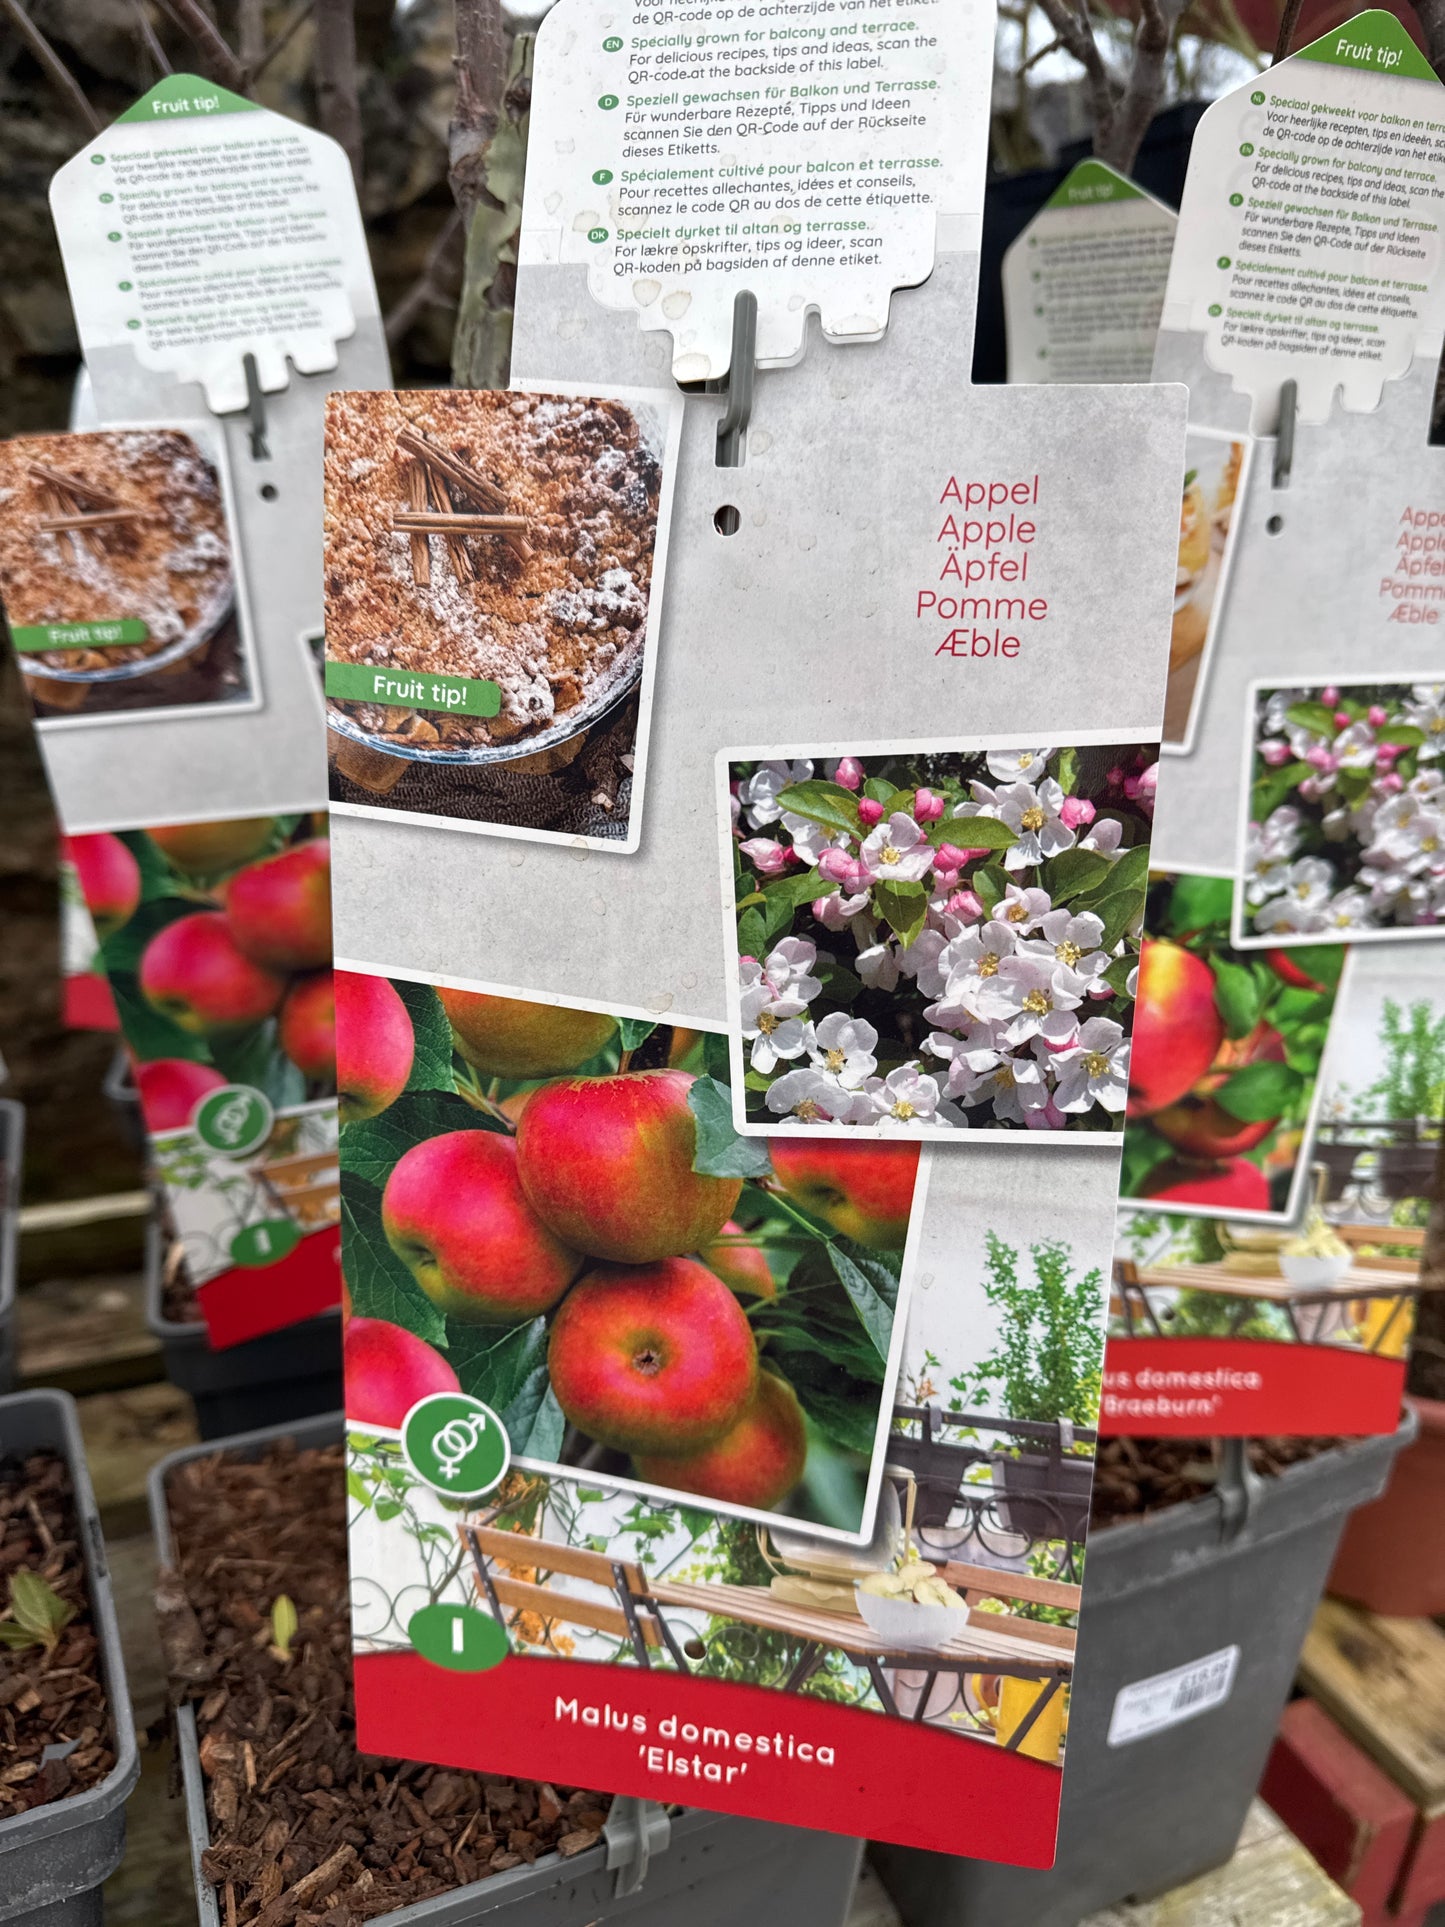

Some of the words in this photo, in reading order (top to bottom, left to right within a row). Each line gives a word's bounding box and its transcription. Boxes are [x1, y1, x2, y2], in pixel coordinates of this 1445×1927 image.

[633, 13, 649, 24] de
[653, 9, 712, 25] QR-code
[716, 10, 733, 21] op
[738, 6, 754, 17] de
[759, 2, 835, 16] achterzijde
[840, 0, 864, 10] van
[606, 40, 619, 48] EN
[696, 34, 739, 47] grown
[744, 30, 765, 41] for
[770, 28, 825, 39] balcony
[830, 23, 857, 35] and
[862, 22, 918, 33] terrace.
[630, 54, 651, 66] For
[655, 51, 712, 64] delicious
[717, 48, 768, 61] recipes,
[773, 45, 797, 59] tips
[801, 42, 828, 55] and
[832, 41, 872, 52] ideas,
[877, 40, 909, 50] scan
[915, 36, 936, 47] the
[1336, 39, 1373, 63] Fruit
[1377, 47, 1403, 69] tip!
[690, 70, 705, 79] at
[709, 66, 730, 77] the
[735, 62, 795, 76] backside
[799, 60, 814, 72] of
[818, 60, 842, 71] this
[847, 56, 883, 69] label.
[152, 98, 190, 114] Fruit
[193, 94, 220, 112] tip!
[605, 98, 612, 106] D
[627, 93, 678, 108] Speziell
[683, 90, 759, 106] gewachsen
[765, 87, 785, 98] für
[790, 85, 838, 97] Balkon
[844, 82, 870, 94] und
[875, 80, 940, 92] Terrasse.
[625, 112, 646, 123] Für
[651, 108, 731, 121] wunderbare
[800, 103, 836, 116] Tipps
[841, 99, 867, 111] und
[872, 98, 910, 109] Ideen
[1270, 96, 1309, 110] Speciaal
[1311, 104, 1355, 118] gekweekt
[1358, 112, 1378, 121] voor
[1381, 114, 1410, 126] balkon
[624, 129, 678, 140] scannen
[683, 126, 702, 137] Sie
[707, 125, 731, 136] den
[803, 119, 826, 131] auf
[831, 118, 854, 129] der
[859, 116, 926, 129] Rückseite
[1268, 111, 1288, 122] Voor
[1290, 114, 1327, 129] heerlijke
[1329, 123, 1369, 137] recepten,
[1373, 129, 1387, 139] tips
[1403, 133, 1432, 147] ideeën,
[622, 146, 663, 157] dieses
[668, 143, 719, 155] Etiketts.
[1263, 126, 1274, 136] de
[1277, 128, 1315, 143] QR-code
[1318, 137, 1329, 146] op
[1332, 137, 1343, 147] de
[1345, 140, 1392, 155] achterzijde
[1395, 149, 1410, 157] van
[1412, 149, 1426, 159] het
[621, 168, 714, 184] Spécialement
[719, 163, 764, 177] cultivé
[769, 165, 802, 177] pour
[807, 161, 854, 172] balcon
[859, 159, 873, 170] et
[879, 159, 942, 169] terrasse.
[1259, 147, 1299, 164] Specially
[1302, 155, 1329, 166] grown
[1333, 158, 1345, 168] for
[1348, 160, 1382, 176] balcony
[1385, 168, 1402, 177] and
[620, 188, 650, 198] Pour
[654, 184, 708, 197] recettes
[712, 181, 794, 195] allechantes,
[798, 179, 833, 190] idées
[839, 178, 852, 188] et
[857, 175, 915, 187] conseils,
[1252, 177, 1290, 191] QR-code
[1293, 184, 1302, 192] at
[1305, 184, 1318, 195] the
[1321, 186, 1358, 200] backside
[1361, 193, 1371, 201] of
[1372, 194, 1386, 204] this
[1389, 196, 1410, 207] label.
[1255, 162, 1270, 172] For
[1272, 165, 1310, 178] delicious
[1312, 172, 1344, 185] recipes,
[1348, 176, 1362, 187] tips
[1365, 180, 1381, 189] and
[1383, 181, 1406, 194] ideas,
[1409, 186, 1429, 195] scan
[1432, 188, 1444, 198] the
[618, 205, 671, 217] scannez
[677, 202, 687, 213] le
[692, 200, 724, 212] code
[729, 199, 749, 213] QR
[754, 201, 770, 209] au
[775, 197, 799, 208] dos
[805, 196, 821, 207] de
[826, 195, 861, 206] cette
[866, 193, 932, 206] étiquette.
[591, 231, 606, 240] DK
[617, 227, 670, 242] Specielt
[675, 225, 720, 240] dyrket
[725, 224, 737, 235] til
[742, 223, 778, 234] altan
[783, 224, 801, 235] og
[807, 221, 869, 231] terrasse.
[615, 246, 637, 256] For
[641, 244, 678, 256] lækre
[682, 241, 751, 256] opskrifter,
[756, 240, 779, 253] tips
[785, 241, 802, 252] og
[807, 237, 845, 249] ideer,
[850, 238, 882, 247] scan
[614, 261, 680, 276] QR-koden
[684, 259, 701, 273] på
[707, 257, 768, 272] bagsiden
[773, 255, 787, 267] af
[792, 255, 834, 266] denne
[840, 253, 881, 265] etiket.
[939, 475, 1038, 512] Appel
[937, 513, 1036, 550] Apple
[939, 546, 1028, 588] Äpfel
[1379, 578, 1445, 600] Pomm
[917, 591, 1048, 620] Pomme
[1387, 603, 1438, 625] Æble
[47, 627, 90, 643] Fruit
[935, 628, 1021, 657] Æble
[374, 675, 425, 700] Fruit
[431, 683, 467, 708] tip!
[1135, 1366, 1263, 1391] domestica
[555, 1696, 647, 1733] Malus
[658, 1714, 835, 1766] domestica
[639, 1744, 748, 1783] 'Elstar'
